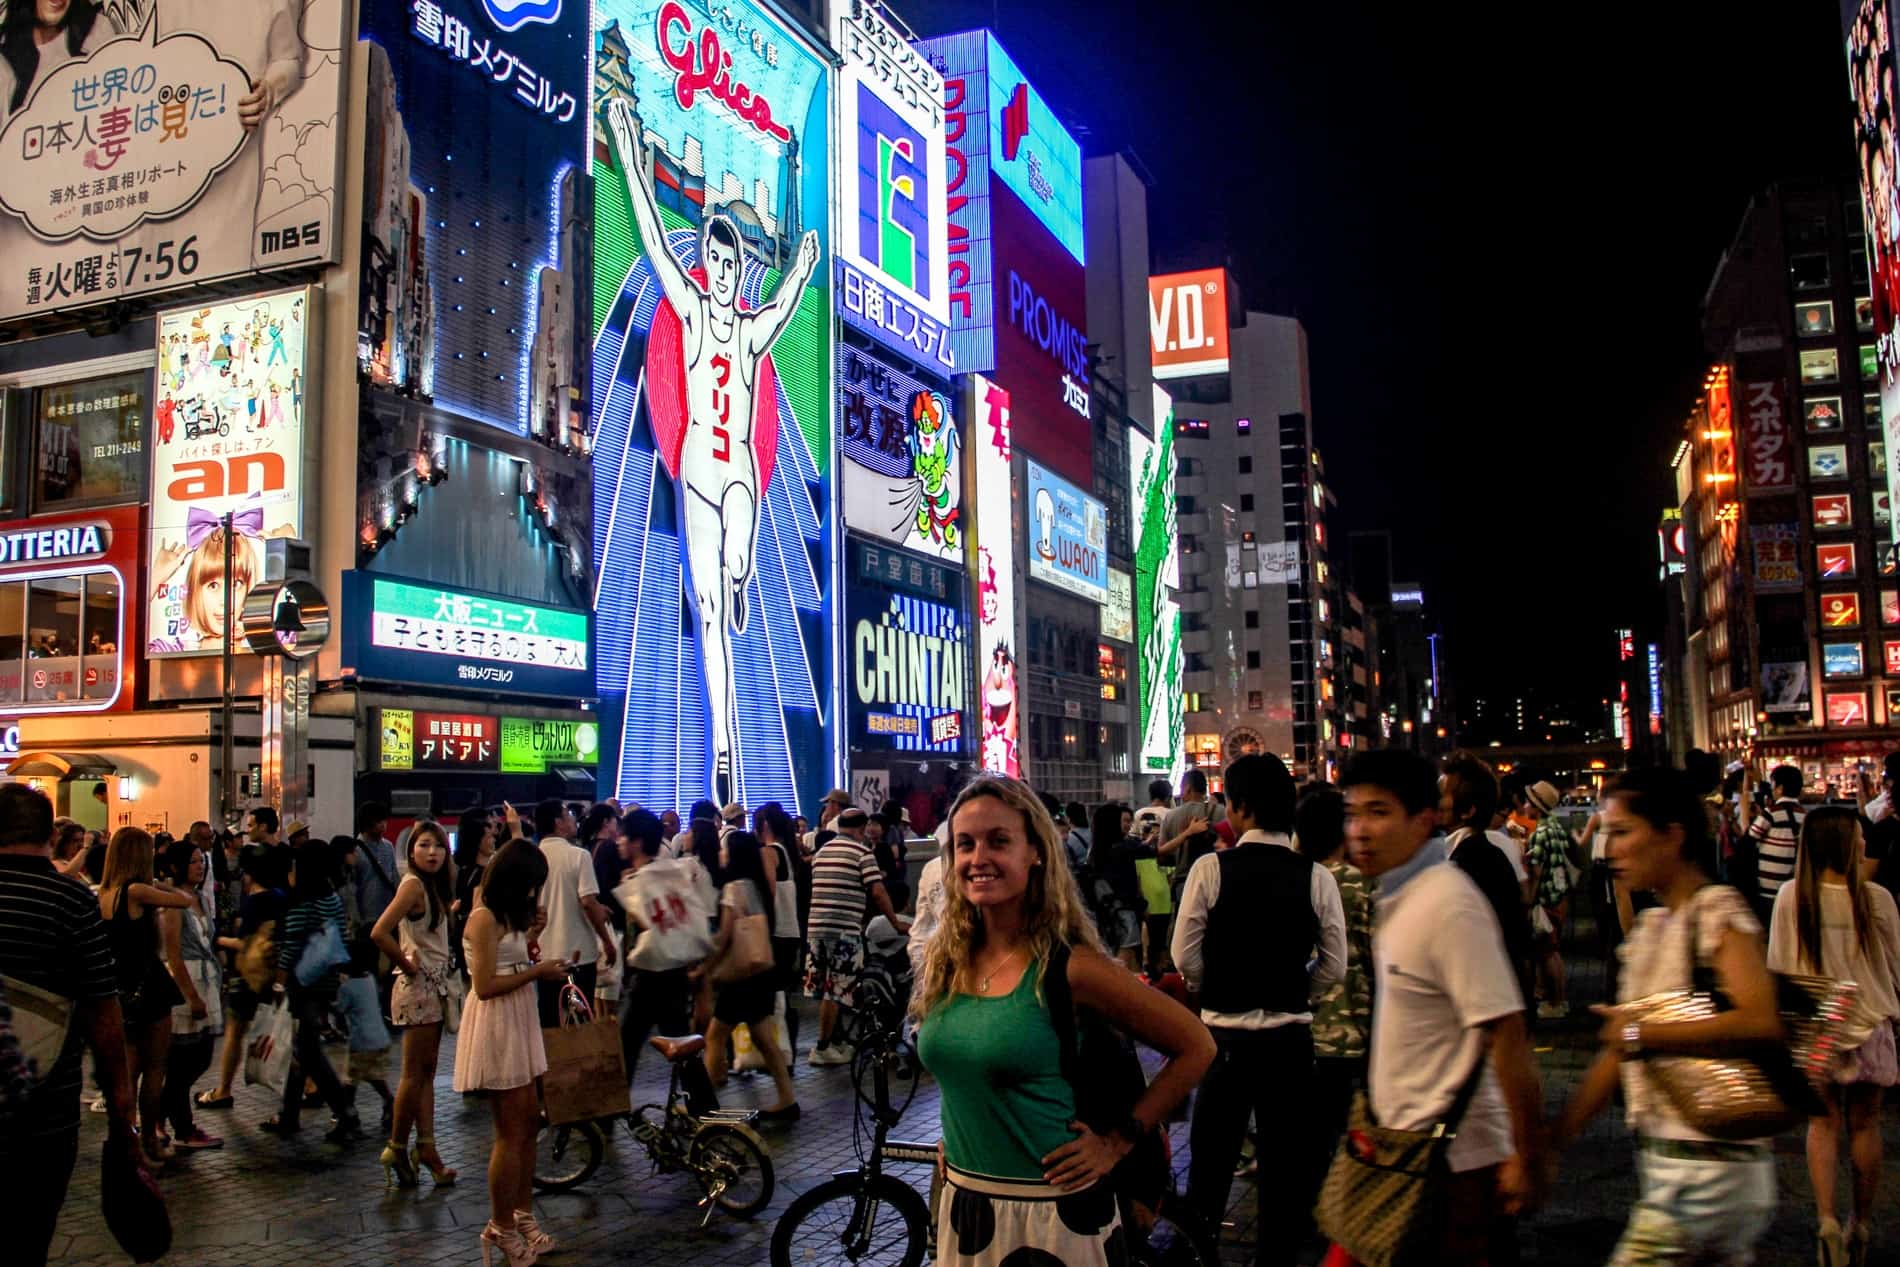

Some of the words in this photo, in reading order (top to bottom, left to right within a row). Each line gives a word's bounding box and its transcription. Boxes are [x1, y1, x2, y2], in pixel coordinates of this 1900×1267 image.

[72, 64, 156, 113] 世界の
[414, 0, 576, 123] 雪印メグミルク
[657, 2, 791, 141] Glico
[850, 31, 941, 129] エステムコート
[50, 160, 187, 206] 海外生活真相リポート
[44, 254, 103, 303] 火曜
[105, 252, 118, 289] よる
[123, 235, 199, 287] 7:56
[261, 221, 321, 254] MBS
[843, 266, 955, 369] 日商エステム
[1009, 269, 1089, 384] PROMISE
[710, 352, 732, 463] グリコ
[1748, 380, 1787, 485] スポタカ
[94, 445, 106, 458] TEL
[167, 452, 285, 501] an
[434, 592, 539, 633] 大阪ニュース
[458, 664, 514, 683] 雪印メグミルク
[856, 617, 963, 711] CHINTAI
[422, 738, 491, 761] アドアド
